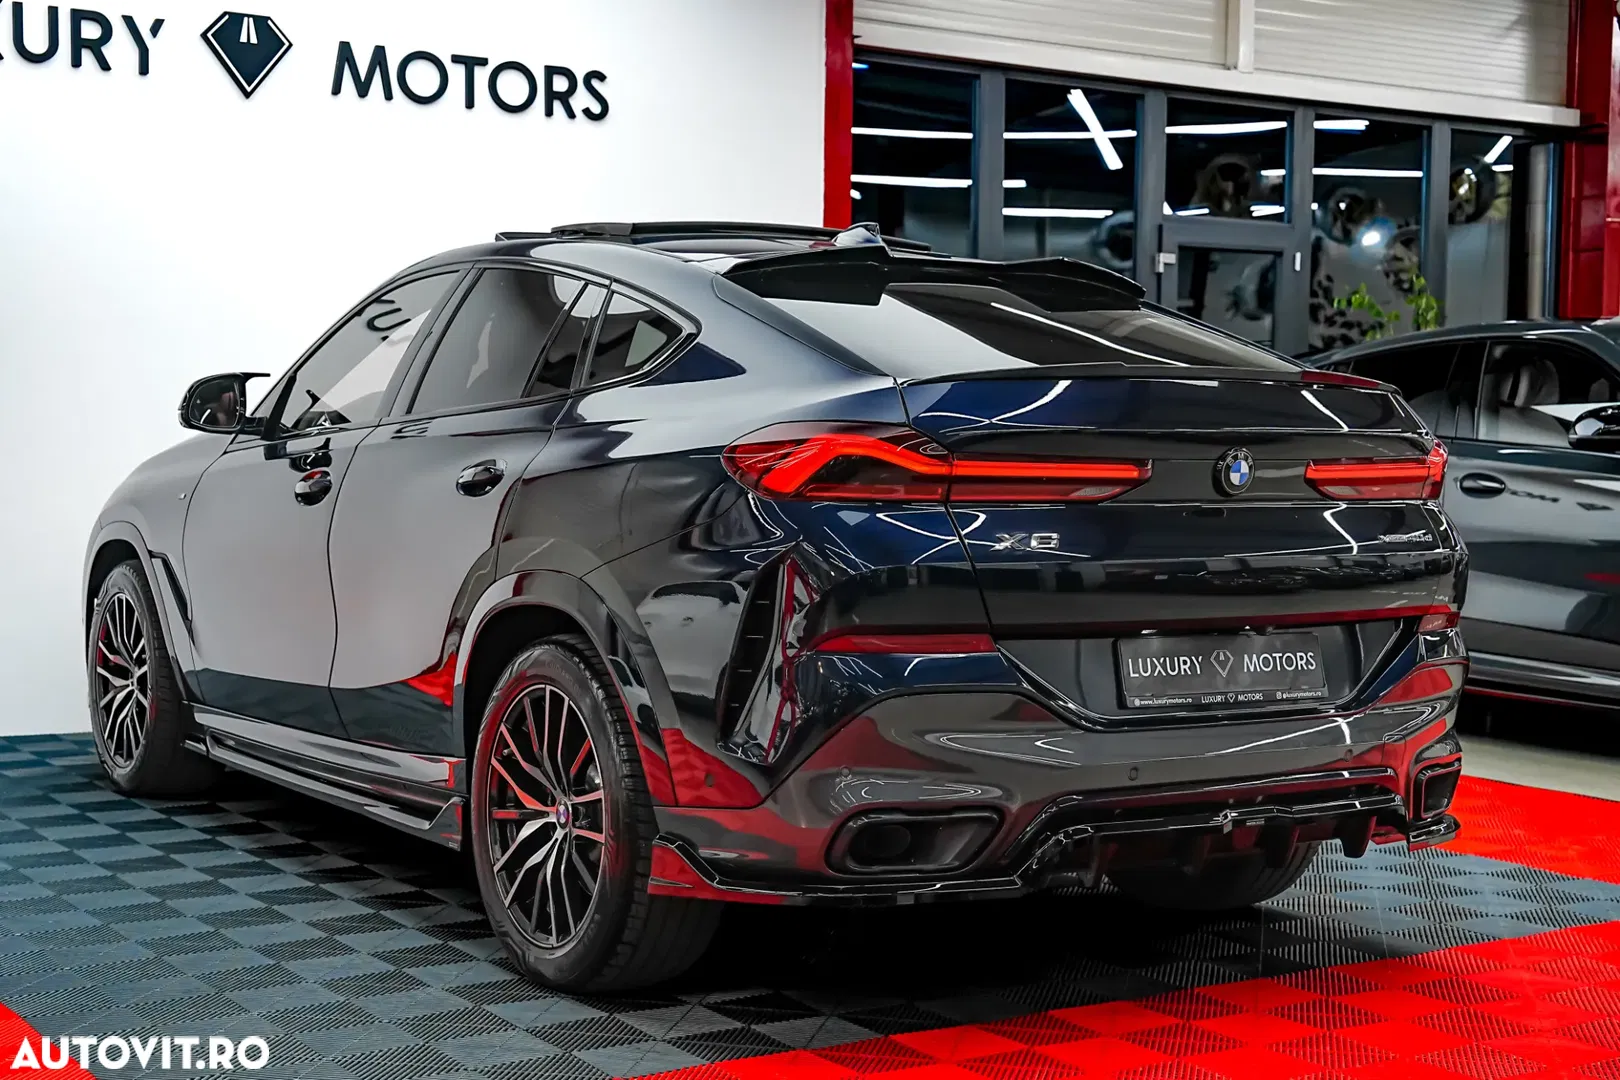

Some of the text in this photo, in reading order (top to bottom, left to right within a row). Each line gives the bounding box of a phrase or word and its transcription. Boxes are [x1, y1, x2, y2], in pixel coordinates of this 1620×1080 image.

[0, 0, 610, 121] URY MOTORS
[1128, 652, 1316, 678] LUXURY MOTORS
[1201, 692, 1264, 704] LUXURY MOTORS
